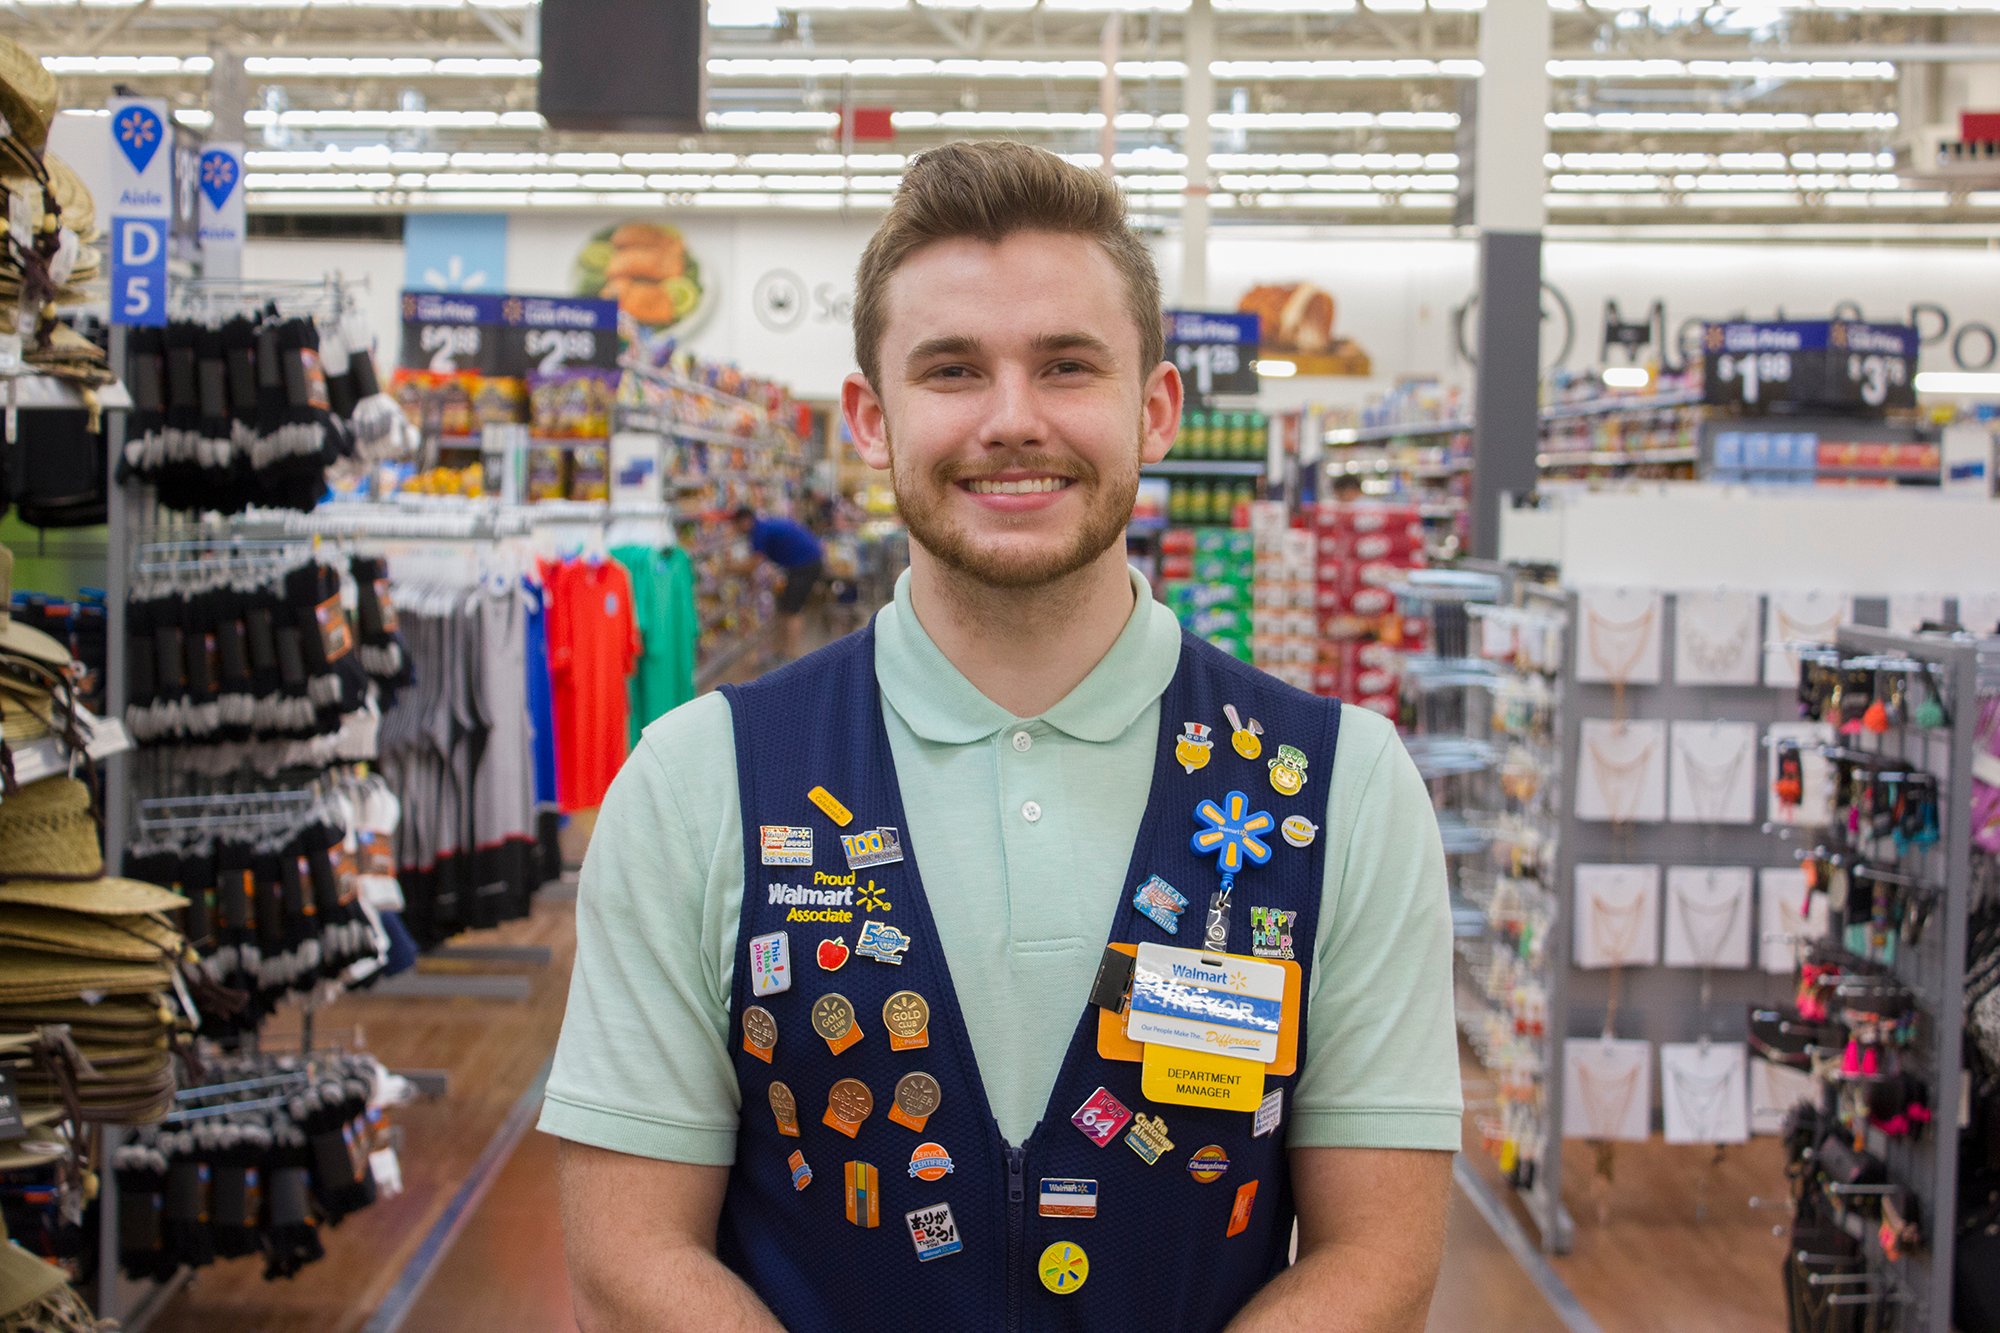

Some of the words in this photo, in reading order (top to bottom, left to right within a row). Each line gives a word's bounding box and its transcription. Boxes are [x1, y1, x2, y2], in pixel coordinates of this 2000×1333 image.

[119, 189, 162, 206] Aisle
[122, 221, 159, 267] D
[124, 276, 151, 317] 5
[845, 833, 884, 857] 100
[764, 856, 774, 864] 55
[778, 856, 811, 864] YEARS
[813, 871, 857, 886] Proud
[768, 883, 853, 905] Walmart
[786, 907, 853, 922] Associate
[1149, 909, 1178, 932] Smile
[1253, 931, 1291, 950] Help
[771, 939, 780, 963] This
[763, 950, 772, 974] that
[1172, 963, 1228, 985] Walmart
[821, 1008, 846, 1028] GOLD
[829, 1018, 847, 1033] CLUB
[892, 1009, 921, 1022] GOLD
[898, 1020, 918, 1029] CLUB
[1153, 1025, 1173, 1035] People
[1174, 1028, 1190, 1037] Make
[1205, 1030, 1263, 1048] Difference
[1167, 1067, 1242, 1085] DEPARTMENT
[901, 1086, 934, 1107] SILVER
[1176, 1083, 1231, 1098] MANAGER
[1098, 1093, 1124, 1118] TOP
[1082, 1109, 1115, 1137] 64
[1135, 1111, 1174, 1151] Customer
[1151, 1114, 1168, 1136] The
[912, 1159, 949, 1170] CERTIFIED
[916, 1150, 944, 1159] SERVICE
[1048, 1183, 1078, 1193] Walmart
